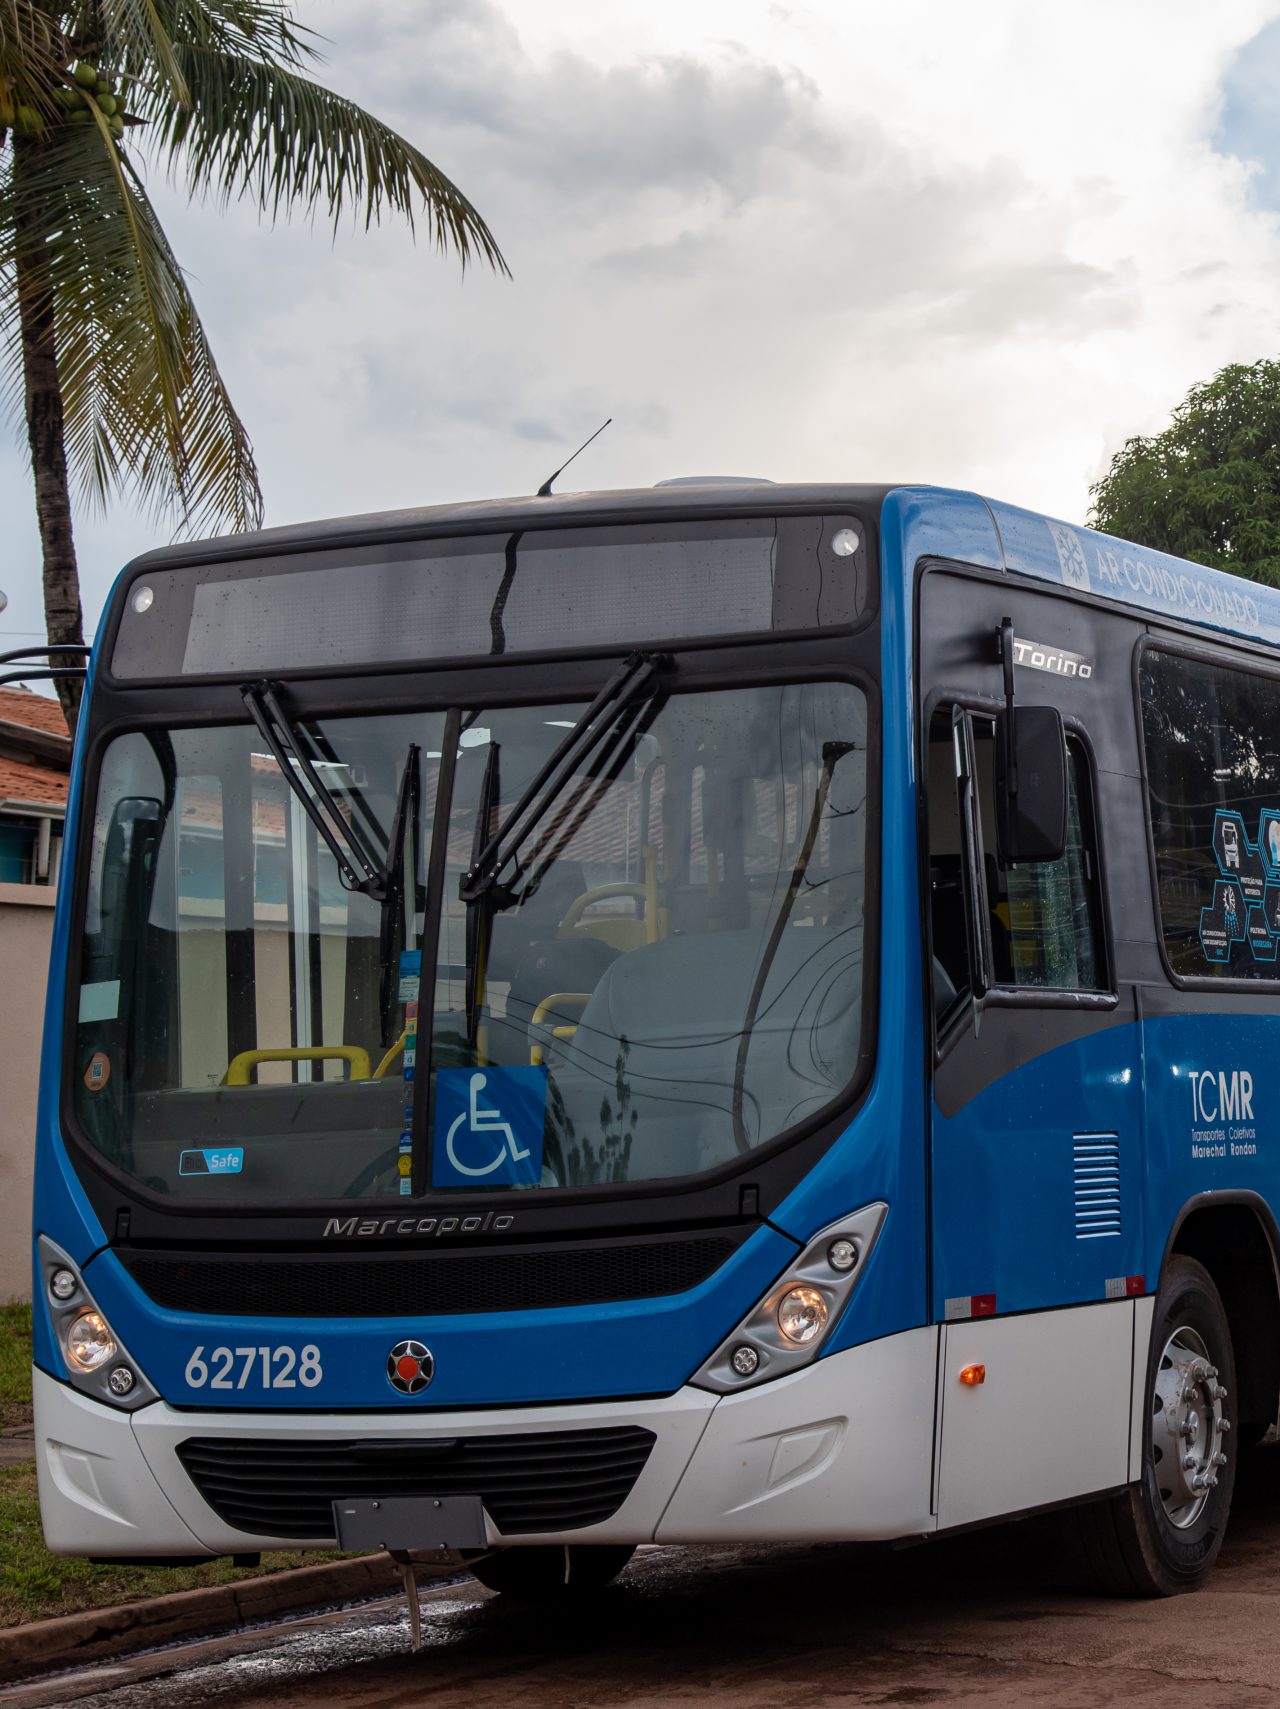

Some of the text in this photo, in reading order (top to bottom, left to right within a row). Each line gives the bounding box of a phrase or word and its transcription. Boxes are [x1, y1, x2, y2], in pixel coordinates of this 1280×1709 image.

[1096, 548, 1260, 628] AR CONDICIONADO
[1013, 642, 1092, 679] Torino
[1188, 1070, 1255, 1123] TCMR
[1191, 1126, 1256, 1143] Transportes Coletivos
[210, 1153, 239, 1169] Safe
[1191, 1142, 1257, 1159] Marechal Rondon
[322, 1211, 515, 1237] Marcopolo
[184, 1343, 323, 1390] 627128
